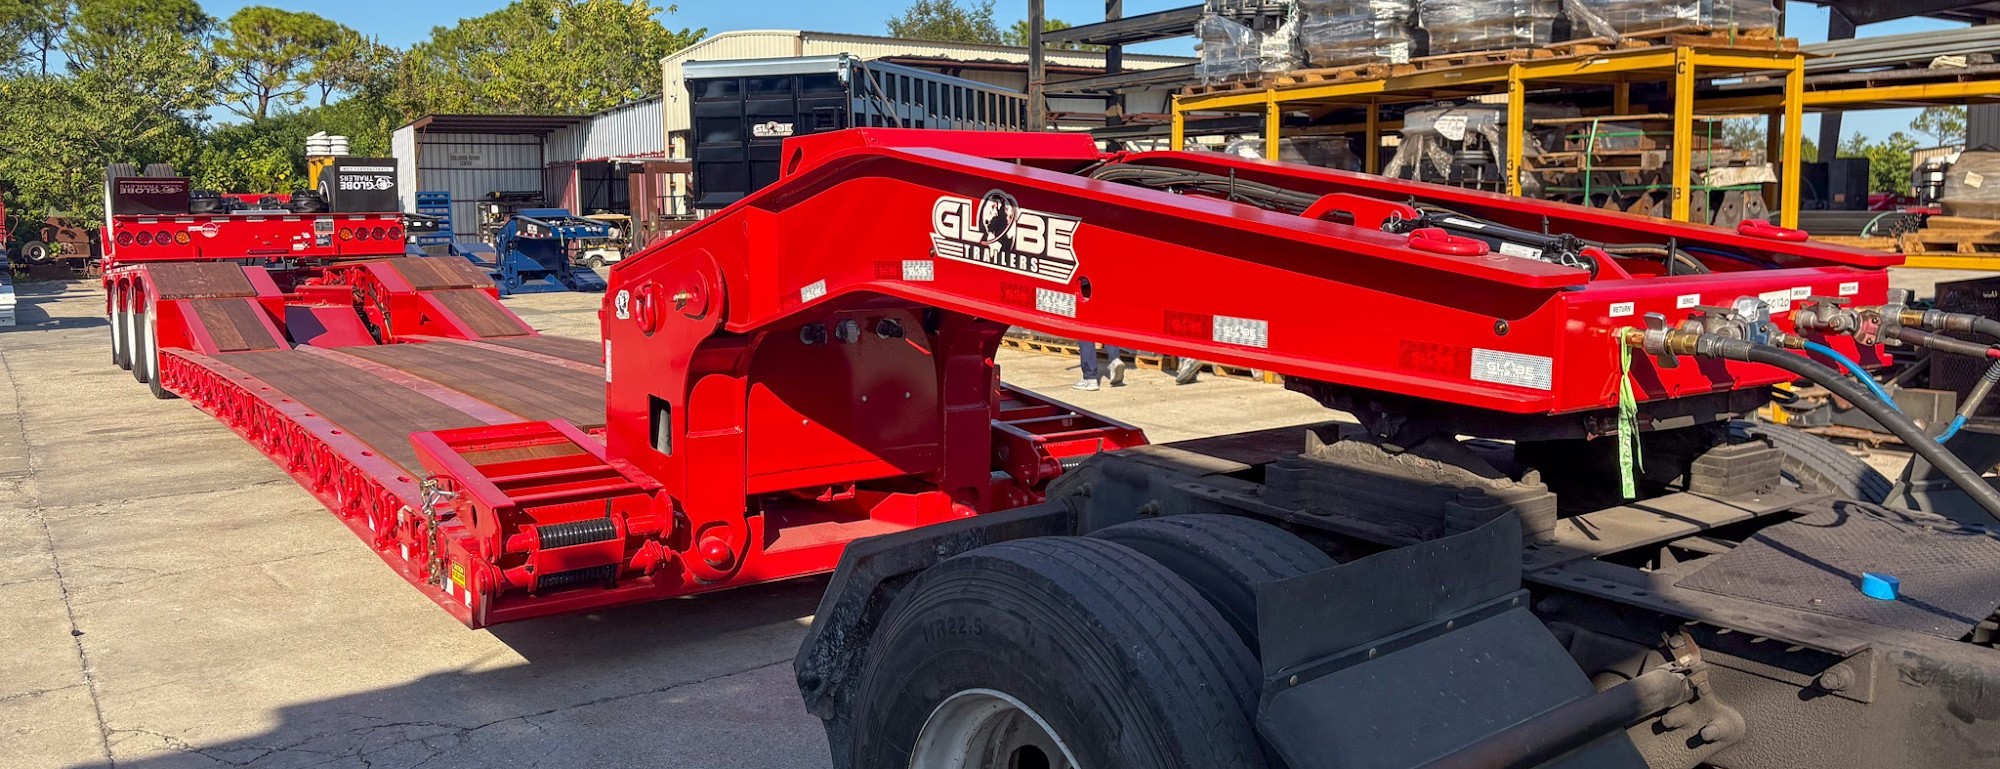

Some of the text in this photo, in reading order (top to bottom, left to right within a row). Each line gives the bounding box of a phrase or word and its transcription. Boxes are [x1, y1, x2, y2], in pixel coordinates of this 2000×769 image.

[753, 121, 794, 133] GLOBE
[340, 174, 373, 182] TRAILERS
[340, 181, 374, 190] GLOBE
[933, 190, 1079, 261] GLOBE
[964, 244, 1040, 272] TRAILERS
[1612, 305, 1631, 313] RETURN
[1486, 360, 1535, 376] GLOBE
